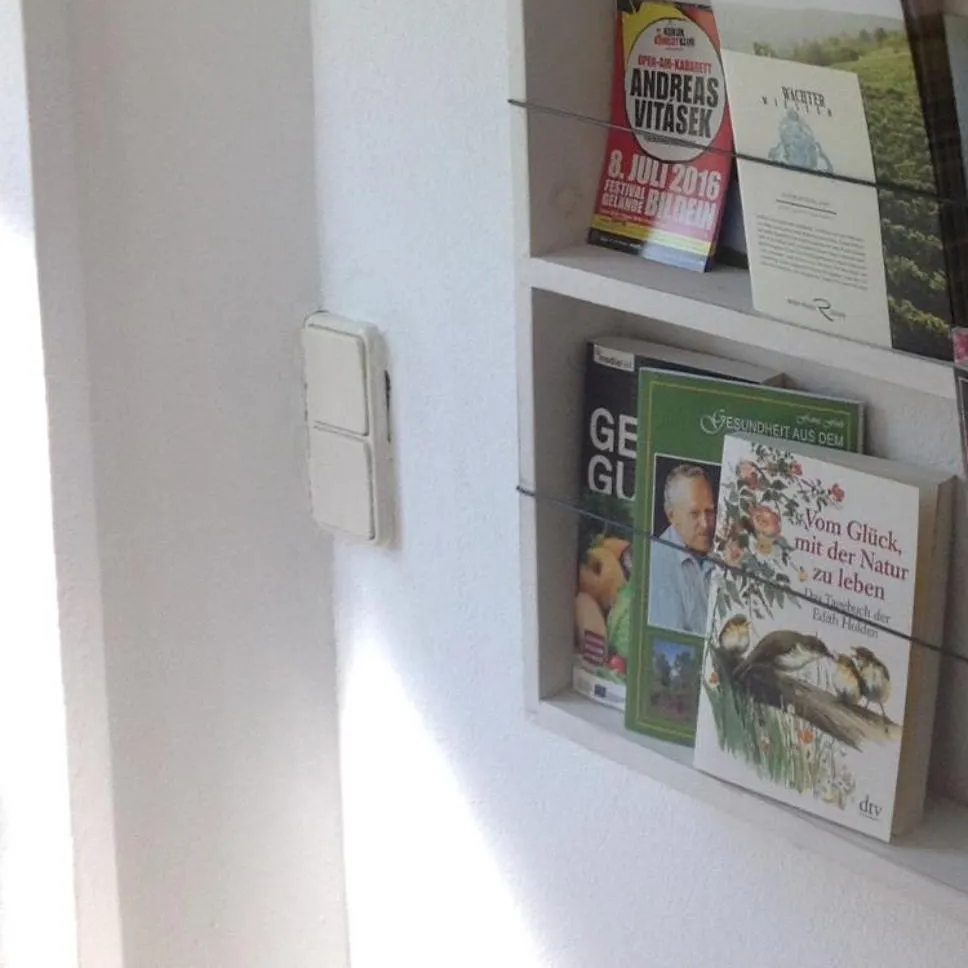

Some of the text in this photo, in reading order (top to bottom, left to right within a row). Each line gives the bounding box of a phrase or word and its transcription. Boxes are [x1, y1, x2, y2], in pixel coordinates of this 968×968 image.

[629, 67, 720, 109] ANDREAS
[603, 179, 646, 200] FESTIVAL
[607, 149, 722, 200] 8. JULI 2016
[589, 407, 638, 459] GE
[700, 408, 791, 437] GESUNDHEIT
[791, 426, 817, 443] AUS
[818, 432, 845, 447] DEM
[804, 508, 902, 558] Vom Glück,
[793, 535, 909, 582] mit der Natur
[811, 569, 886, 602] zu leben
[858, 793, 884, 818] dtv
